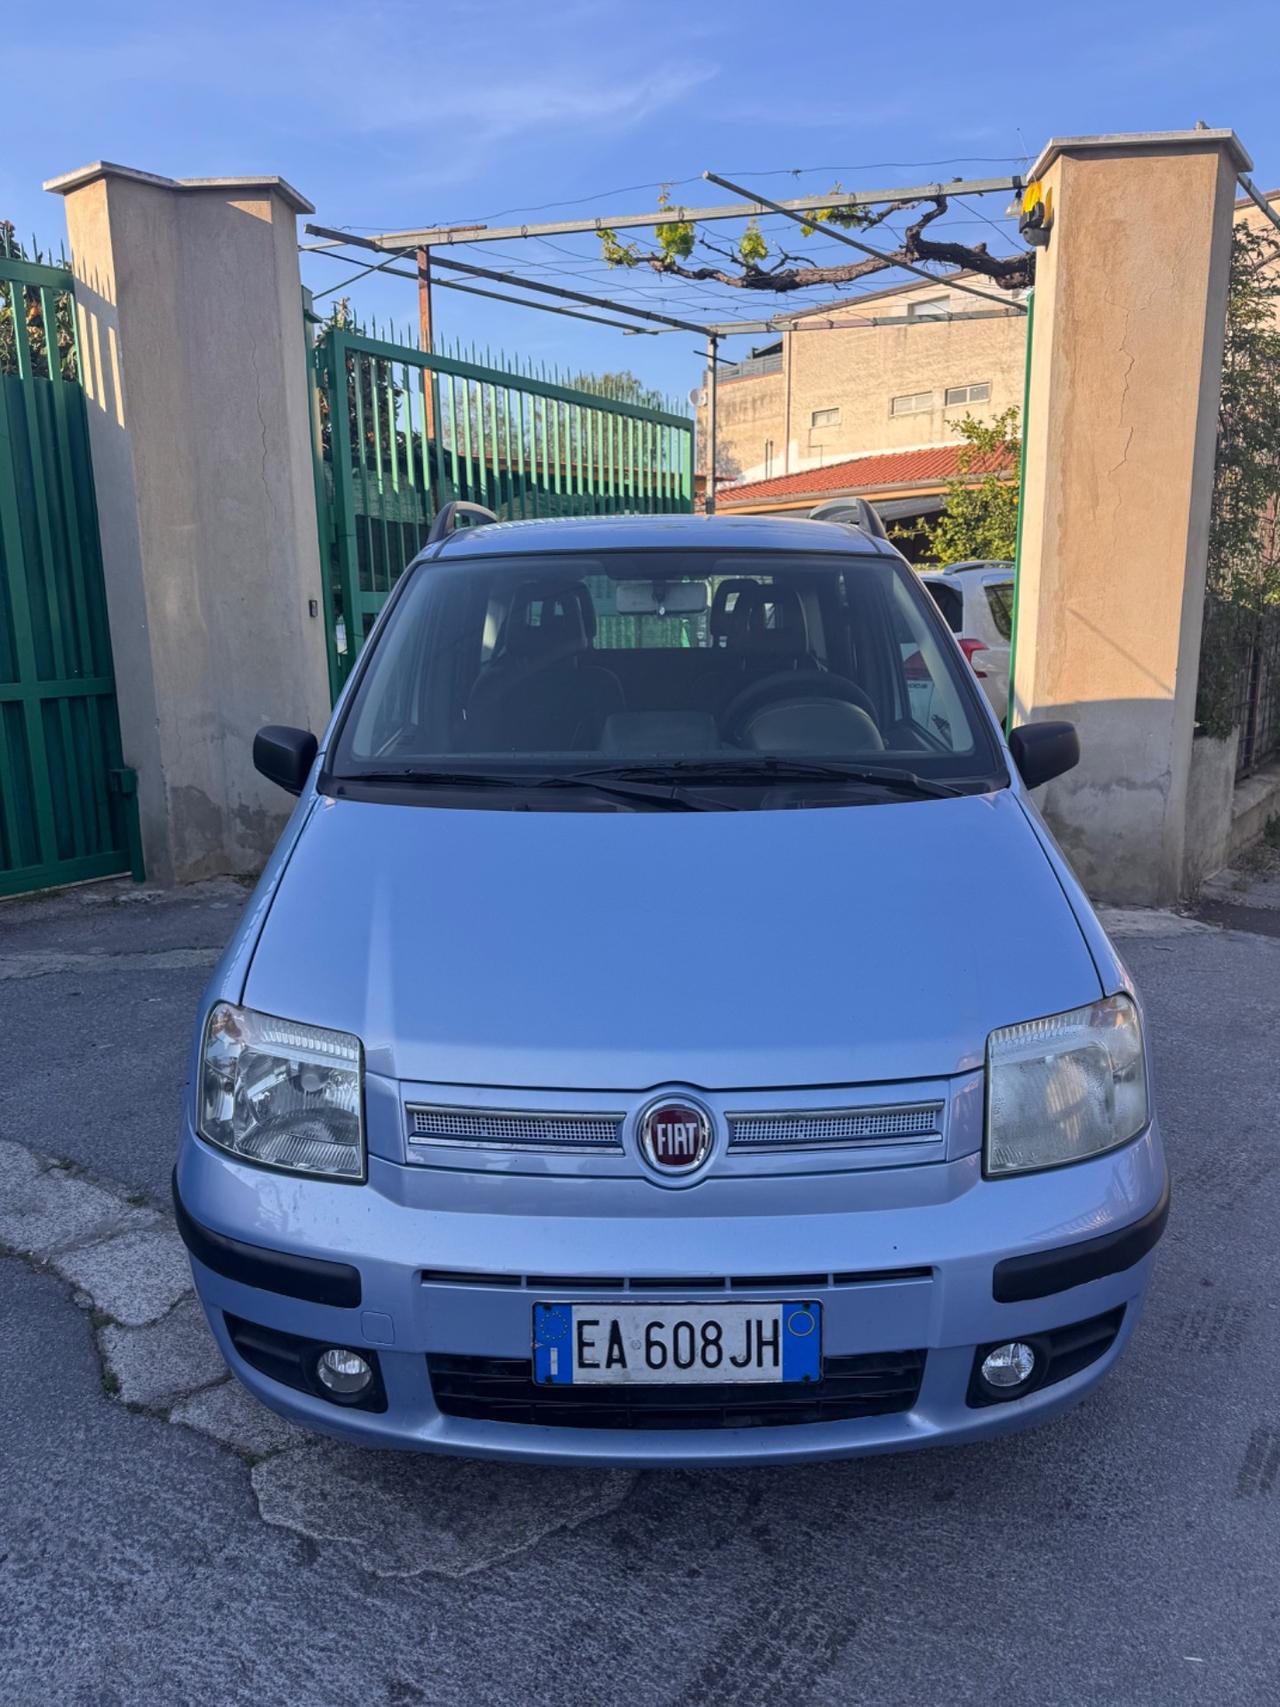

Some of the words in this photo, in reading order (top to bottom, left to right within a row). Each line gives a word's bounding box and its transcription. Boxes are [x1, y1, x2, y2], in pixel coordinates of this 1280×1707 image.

[656, 1122, 698, 1156] FIAT
[576, 1319, 627, 1369] EA
[645, 1320, 723, 1369] 608
[729, 1318, 780, 1368] JH
